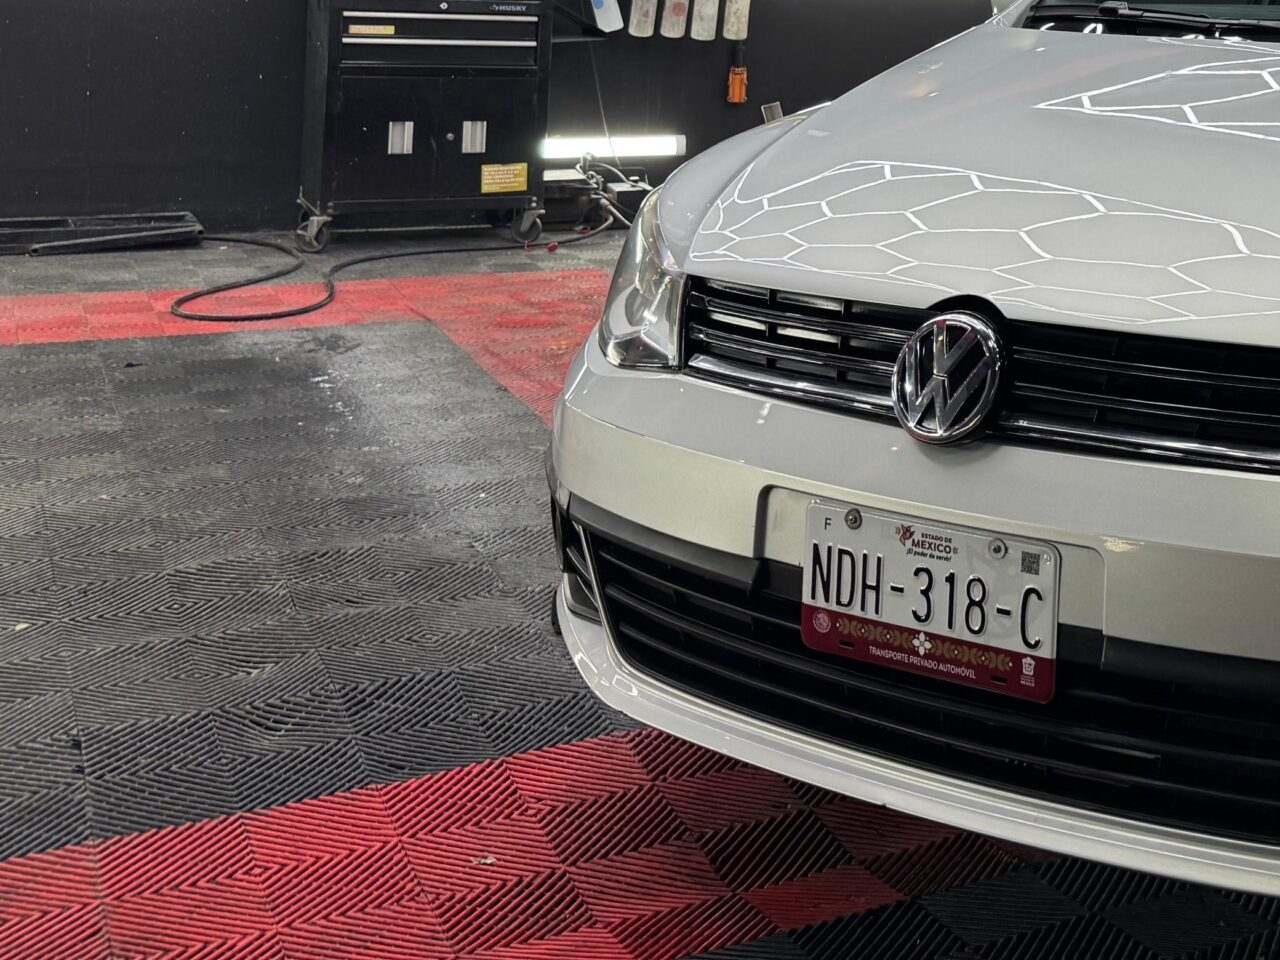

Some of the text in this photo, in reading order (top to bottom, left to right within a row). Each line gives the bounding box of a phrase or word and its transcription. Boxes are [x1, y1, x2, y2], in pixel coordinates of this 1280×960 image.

[499, 4, 527, 12] HUSKY
[824, 517, 832, 531] F
[921, 533, 943, 541] ESTADO
[811, 541, 1044, 650] NDH-318-C
[869, 645, 976, 679] TRANSPORTE PRIVADO AUTOMÓVIL
